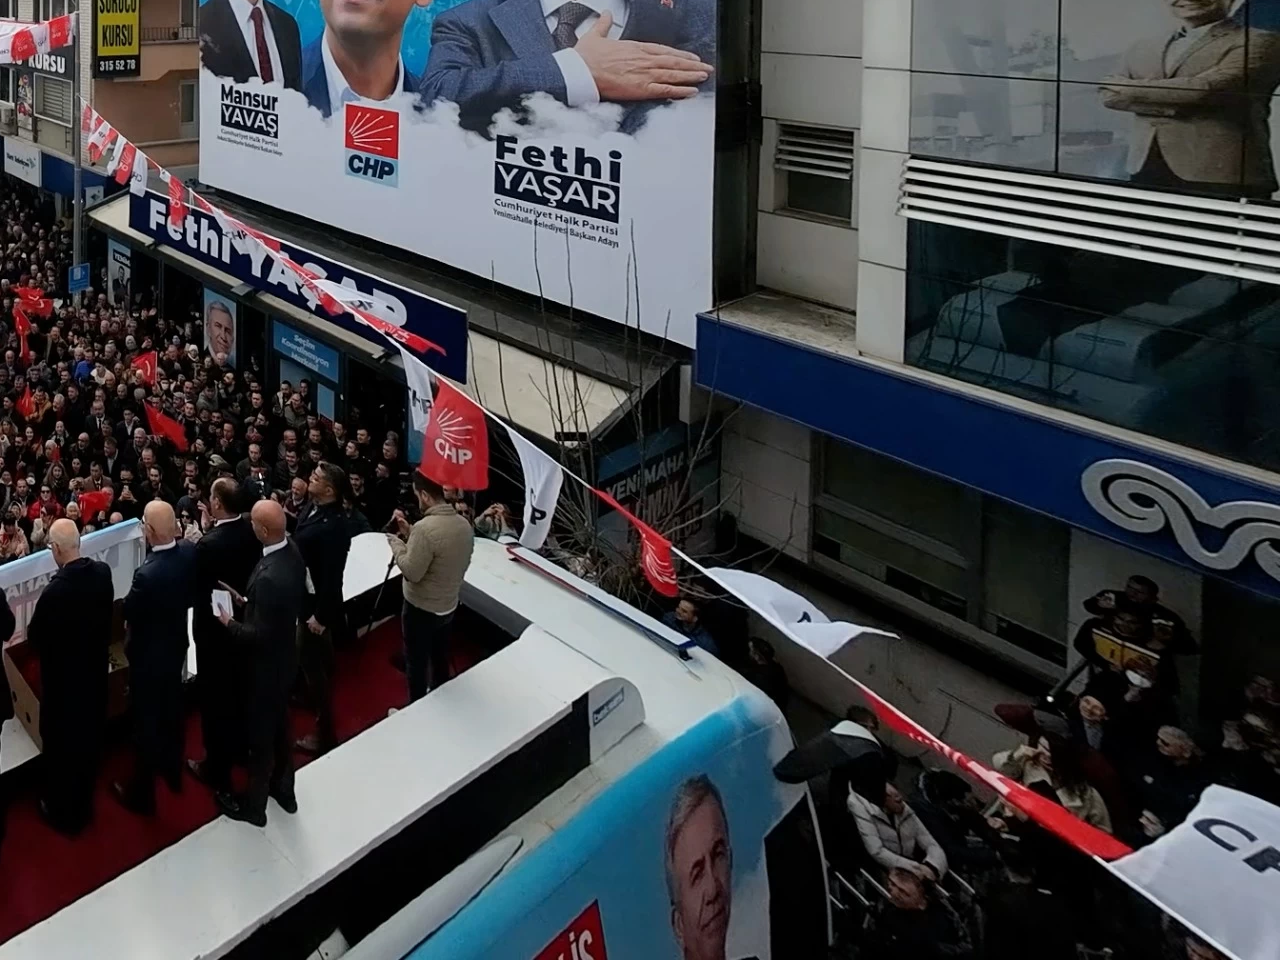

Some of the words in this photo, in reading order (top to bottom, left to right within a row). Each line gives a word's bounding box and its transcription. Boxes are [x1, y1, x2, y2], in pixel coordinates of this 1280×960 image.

[102, 24, 134, 47] KURSU
[28, 53, 66, 74] KURSU
[100, 61, 114, 71] 315
[115, 60, 125, 71] 52
[126, 59, 136, 70] 78
[221, 83, 278, 111] Mansur
[222, 105, 277, 137] YAVAŞ
[349, 154, 395, 180] CHP
[496, 134, 622, 184] Fethi
[497, 164, 616, 214] YAŞAR
[493, 207, 532, 225] Yenimahalle
[494, 198, 552, 219] Cumhuriyet
[555, 213, 580, 227] Halk
[582, 220, 618, 236] Partisi
[434, 438, 473, 465] CHP
